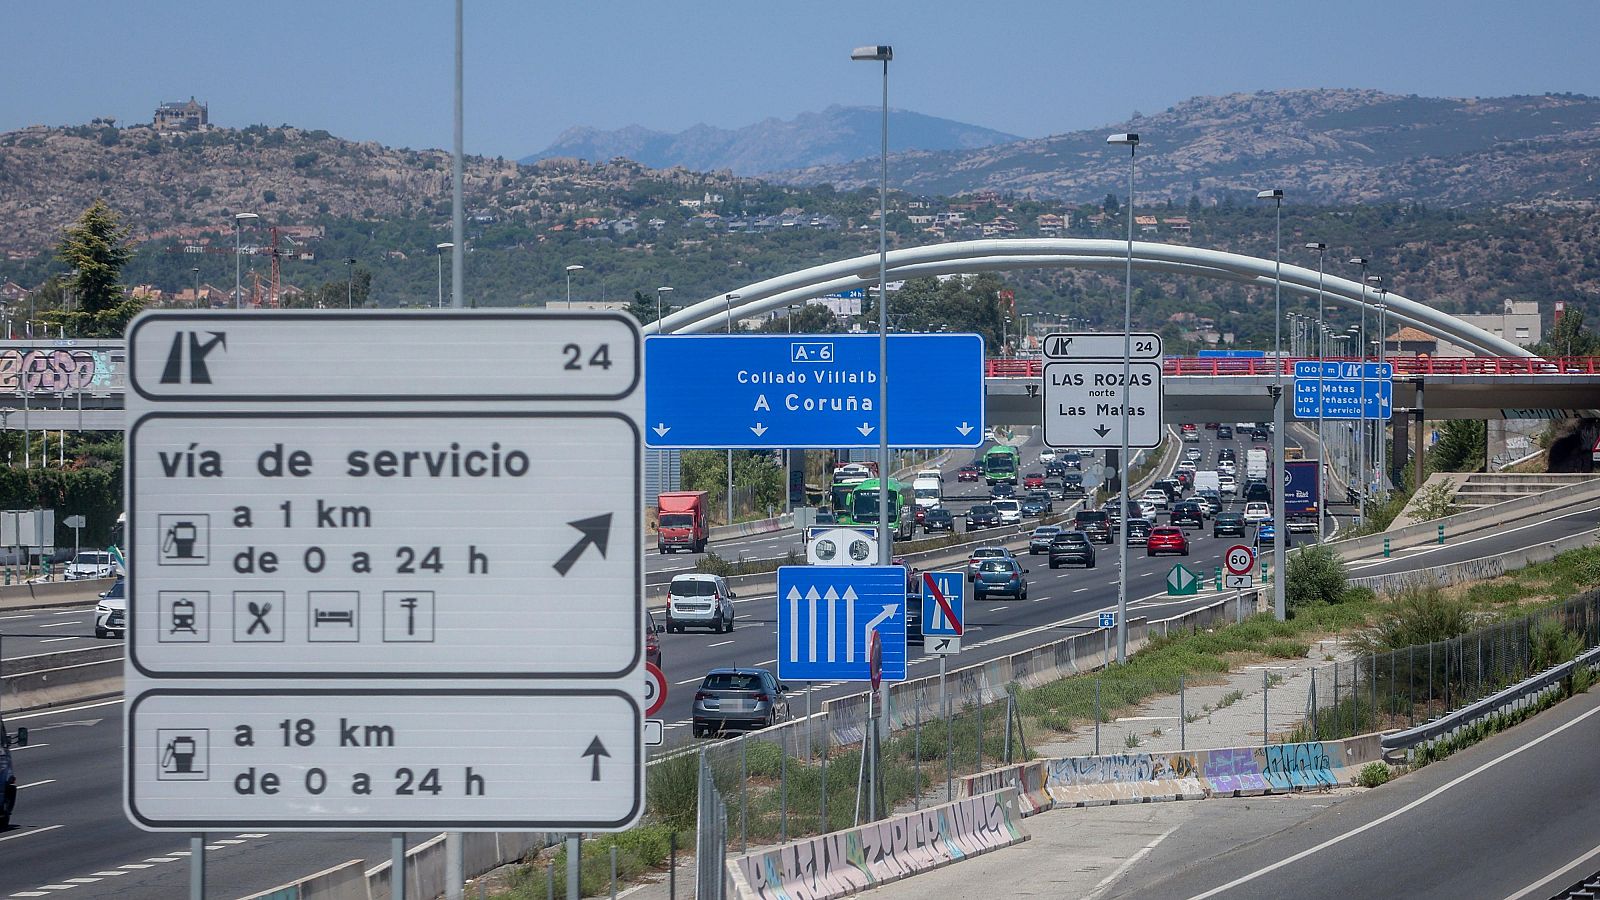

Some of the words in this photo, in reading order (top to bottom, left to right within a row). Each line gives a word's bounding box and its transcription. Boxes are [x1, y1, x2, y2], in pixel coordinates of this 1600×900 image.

[794, 345, 831, 361] A-6
[1136, 342, 1153, 352] 24
[562, 343, 613, 371] 24
[737, 370, 807, 384] Collado
[813, 370, 888, 384] Villalb
[1052, 373, 1084, 387] LAS
[1094, 373, 1152, 387] ROZAS
[1089, 389, 1115, 397] norte
[1298, 384, 1317, 393] Las
[1322, 384, 1355, 393] Matas
[754, 394, 771, 412] A
[785, 394, 873, 411] Coruña
[1059, 403, 1086, 416] Las
[1096, 403, 1146, 416] Matas
[158, 442, 223, 478] vía
[257, 443, 313, 478] de
[346, 442, 530, 478] servicio
[233, 505, 253, 528] a
[280, 500, 292, 528] 1
[317, 499, 371, 528] km
[233, 546, 279, 574] de
[303, 546, 326, 574] 0
[351, 551, 372, 574] a
[395, 546, 444, 574] 24
[468, 545, 488, 574] h
[1231, 554, 1247, 565] 60
[234, 724, 255, 747] a
[279, 718, 315, 747] 18
[339, 717, 395, 747] km
[234, 767, 280, 795] de
[305, 767, 327, 795] 0
[351, 772, 373, 796] a
[395, 767, 442, 796] 24
[465, 766, 485, 796] h
